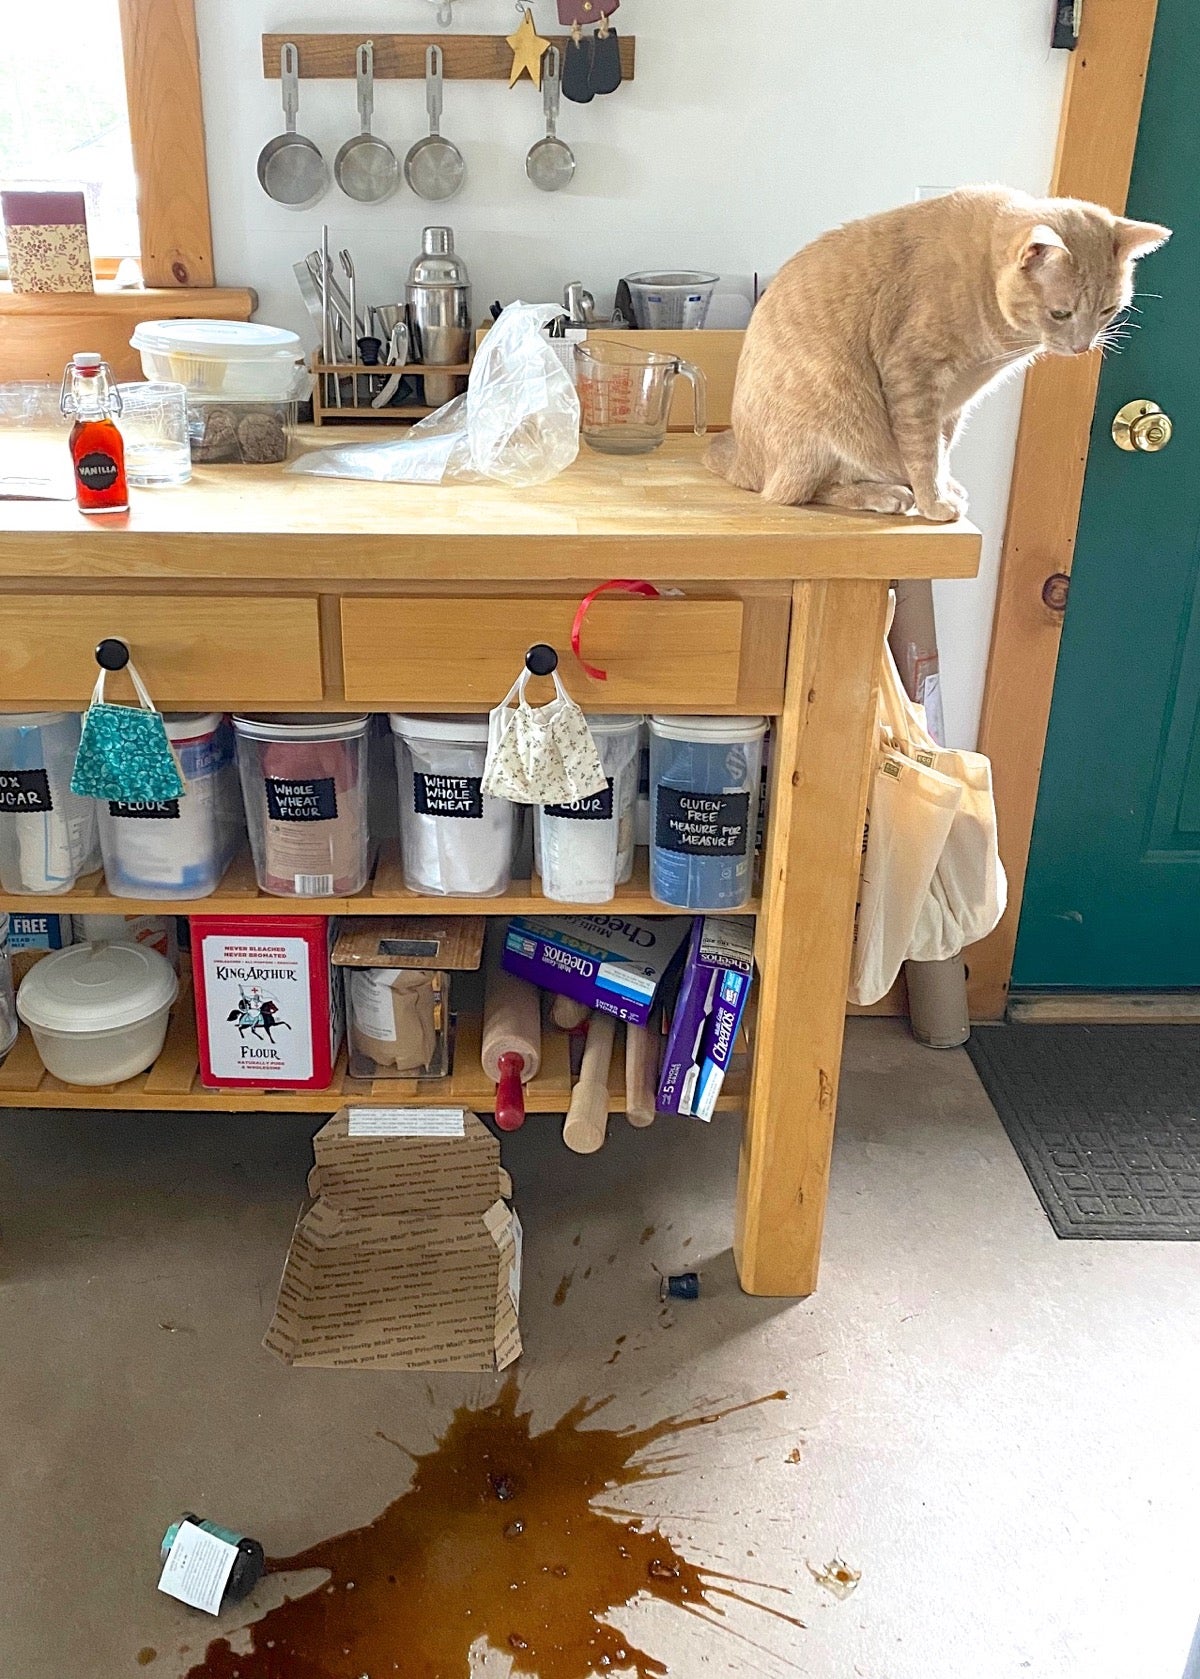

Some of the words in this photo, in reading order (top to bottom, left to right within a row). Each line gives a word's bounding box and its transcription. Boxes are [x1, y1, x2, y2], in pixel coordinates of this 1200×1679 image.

[79, 466, 117, 475] VANILLA
[424, 775, 468, 789] WHITE
[274, 784, 314, 795] WHOLE
[425, 787, 470, 800] WHOLE
[0, 791, 42, 805] UGAR
[275, 796, 320, 807] WHEAT
[427, 798, 473, 811] WHEAT
[680, 797, 727, 811] GLUTEN-
[280, 807, 320, 817] FLOUR
[550, 799, 603, 812] LOUR
[687, 810, 719, 823] FREE
[669, 819, 719, 835] MEASURE
[722, 825, 742, 837] FOR
[681, 833, 738, 847] MEASURE
[13, 918, 48, 934] FREE
[543, 945, 594, 978] Cheerios
[701, 953, 750, 972] Cheerios
[216, 966, 244, 981] KING
[244, 966, 298, 982] ARTHUR
[619, 1008, 629, 1019] 5
[712, 1009, 736, 1062] Cheerios
[240, 1045, 281, 1061] FLOUR
[663, 1085, 675, 1094] 5
